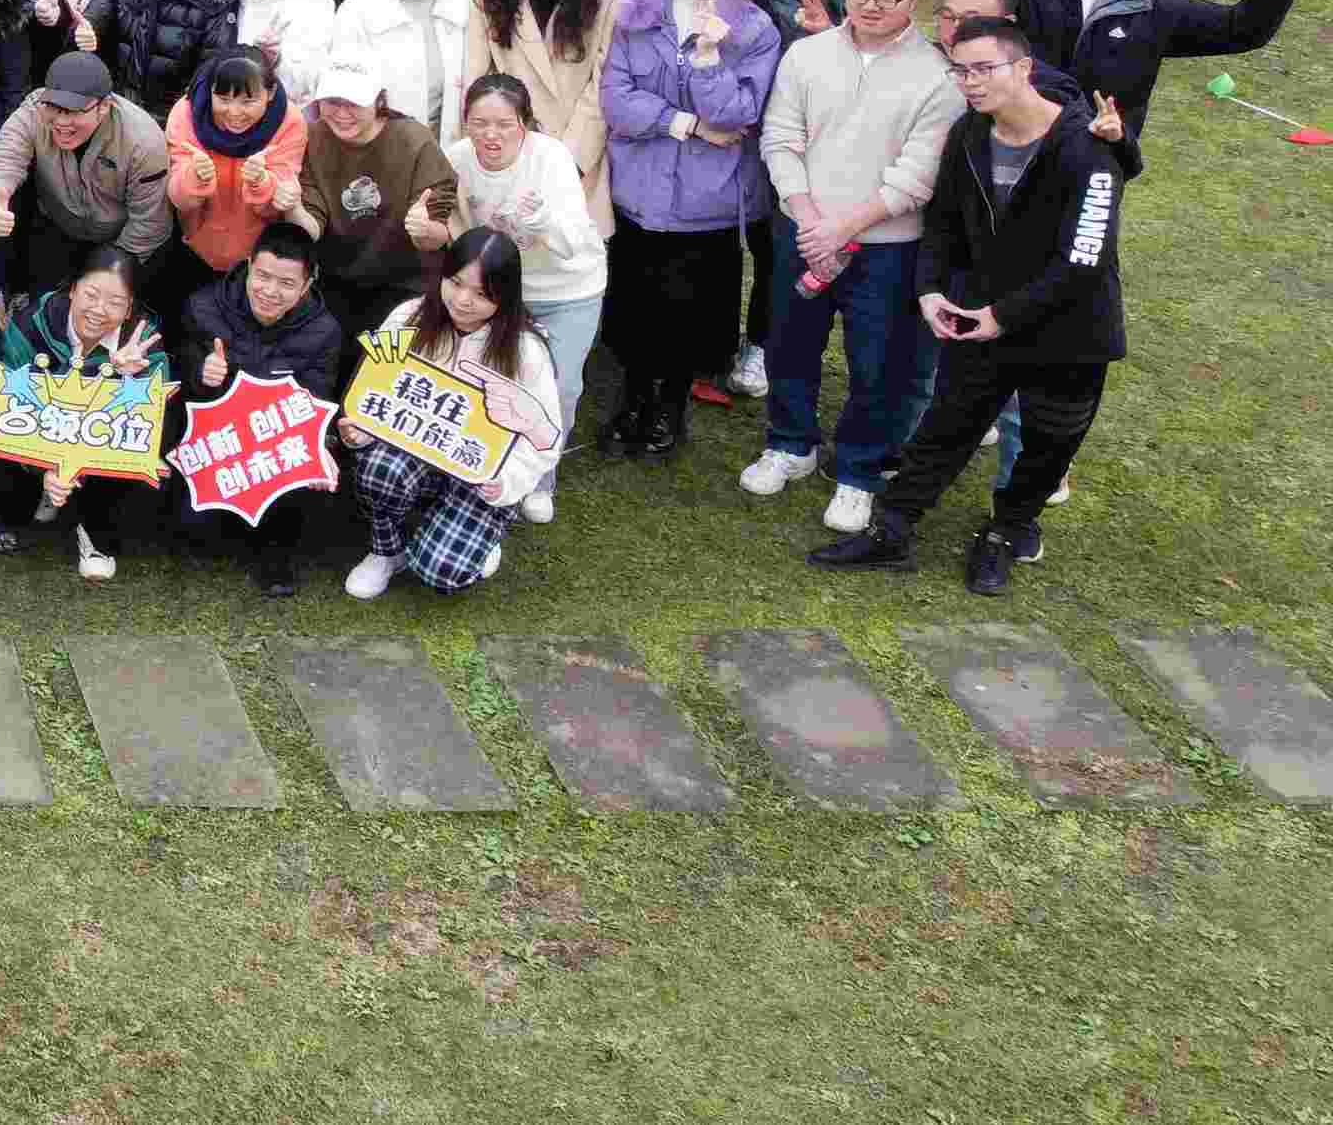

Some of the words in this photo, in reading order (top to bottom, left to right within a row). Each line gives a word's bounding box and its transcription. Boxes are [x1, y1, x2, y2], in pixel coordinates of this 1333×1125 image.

[1069, 173, 1112, 267] CHANGE
[179, 427, 241, 475] 创新
[250, 389, 317, 439] 创造
[359, 393, 486, 469] 我们能赢
[397, 372, 469, 428] 稳住
[215, 441, 312, 499] 创未来
